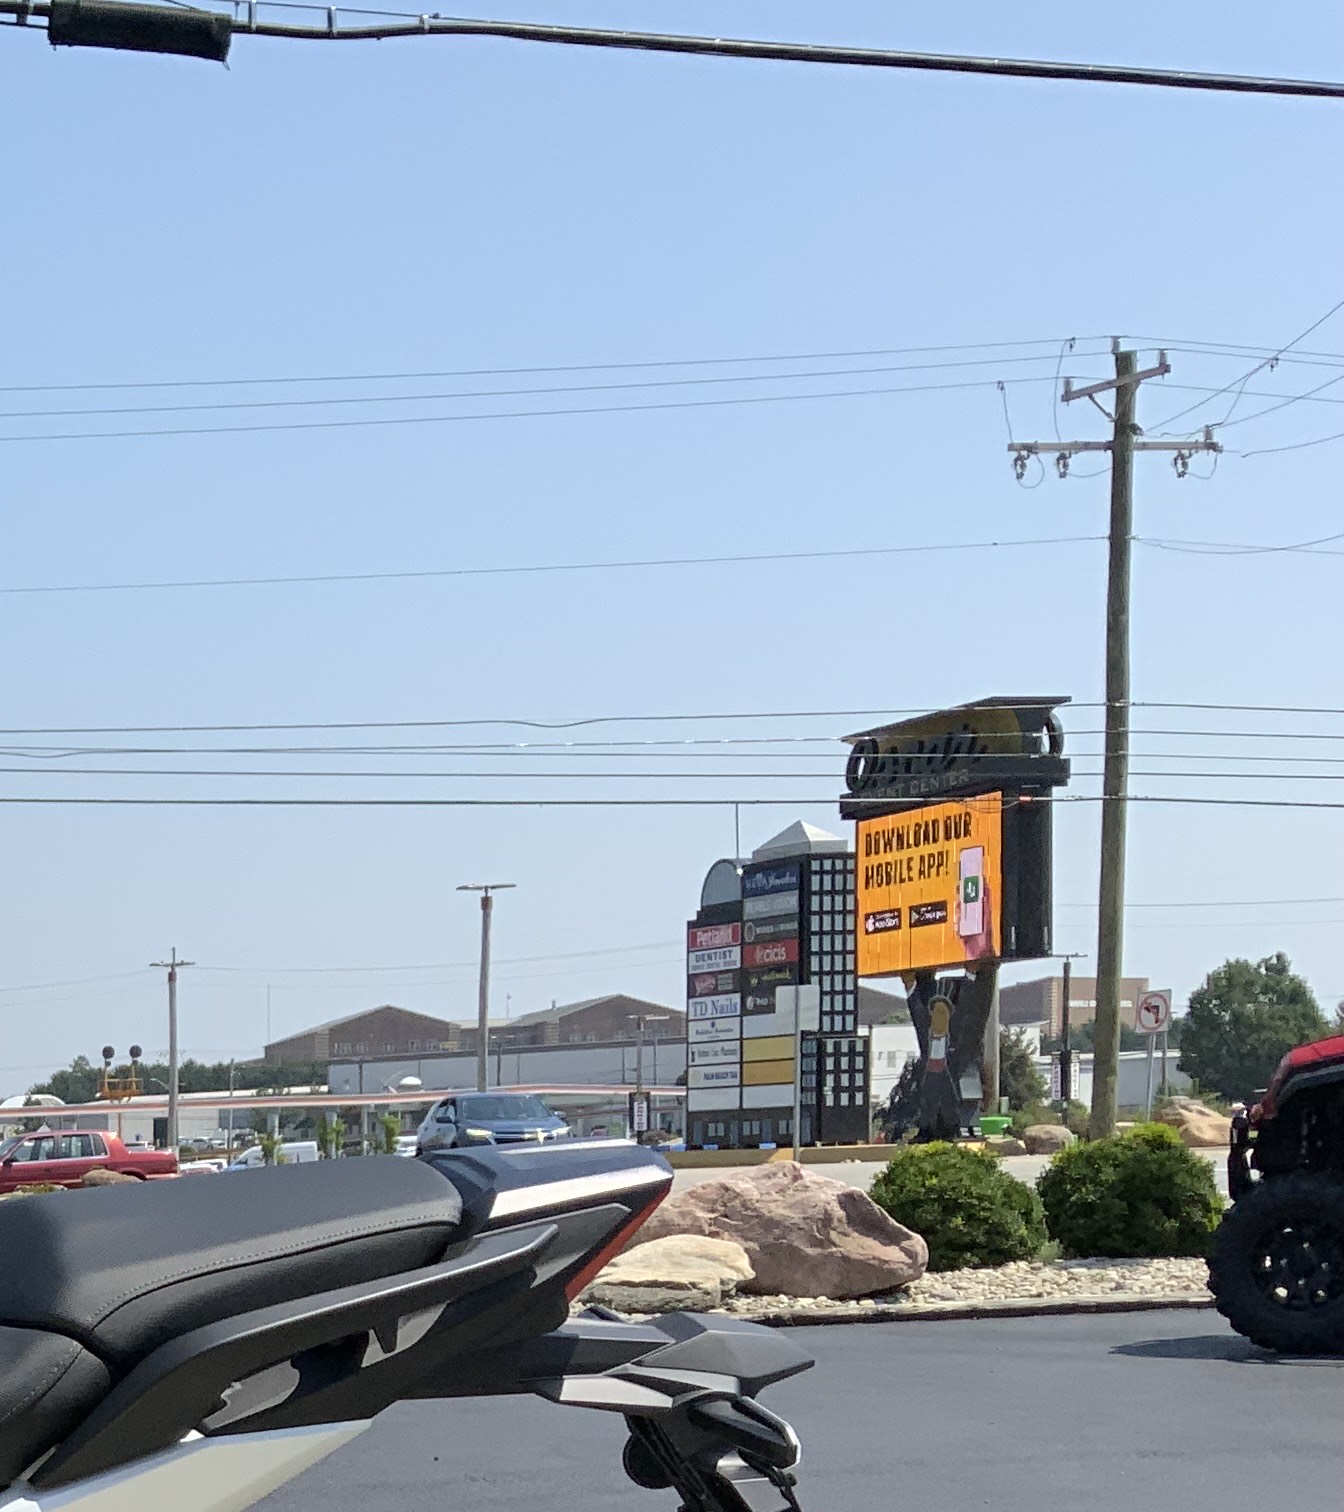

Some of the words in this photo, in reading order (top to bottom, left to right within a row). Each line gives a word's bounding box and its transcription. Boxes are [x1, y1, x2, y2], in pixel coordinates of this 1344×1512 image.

[865, 818, 940, 857] DOWNLOAD
[944, 812, 972, 841] OUR
[865, 857, 914, 890] MOBILE
[919, 850, 949, 880] APP!
[695, 950, 733, 963] DENTIST
[692, 1001, 708, 1017] TD
[711, 998, 738, 1015] Nails
